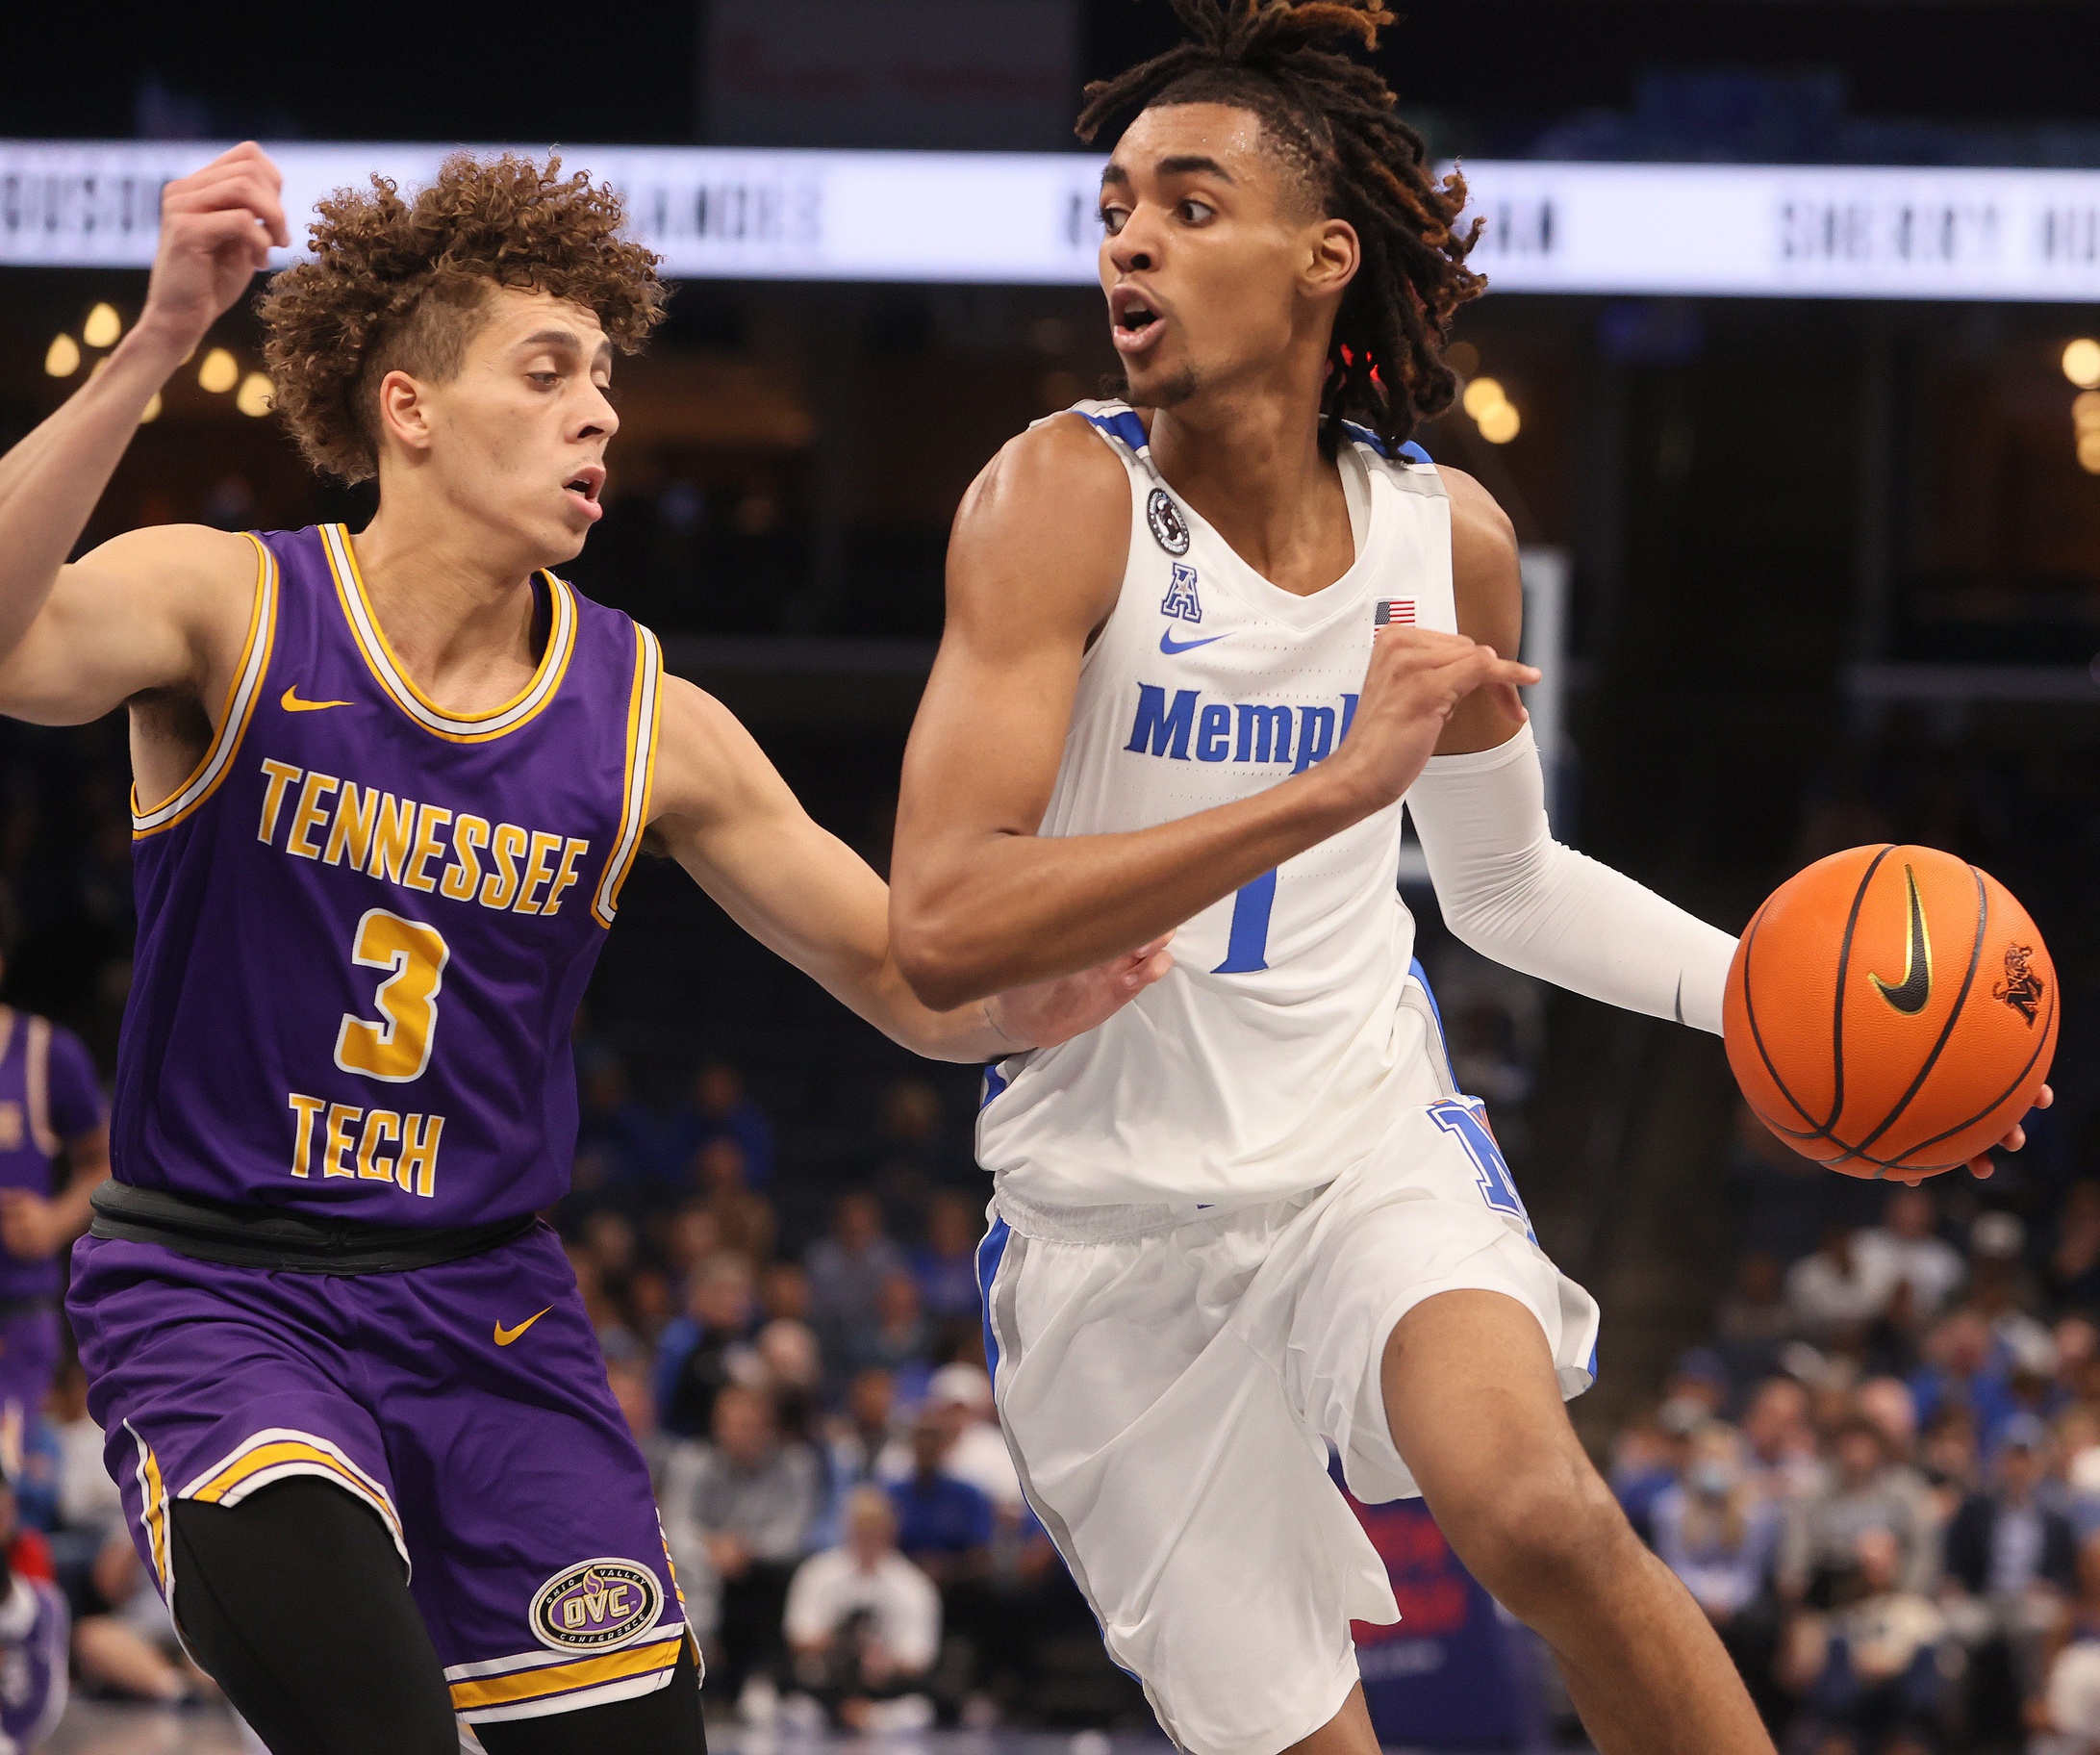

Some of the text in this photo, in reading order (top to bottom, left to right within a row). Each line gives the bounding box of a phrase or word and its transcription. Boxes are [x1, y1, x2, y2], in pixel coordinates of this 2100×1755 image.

[257, 757, 590, 916] TENNESSEE
[334, 907, 450, 1083] 3
[289, 1092, 445, 1198] TECH
[545, 1569, 646, 1605] OHIO VALLEY
[563, 1585, 631, 1629] OVC
[559, 1613, 645, 1642] CONFERENCE
